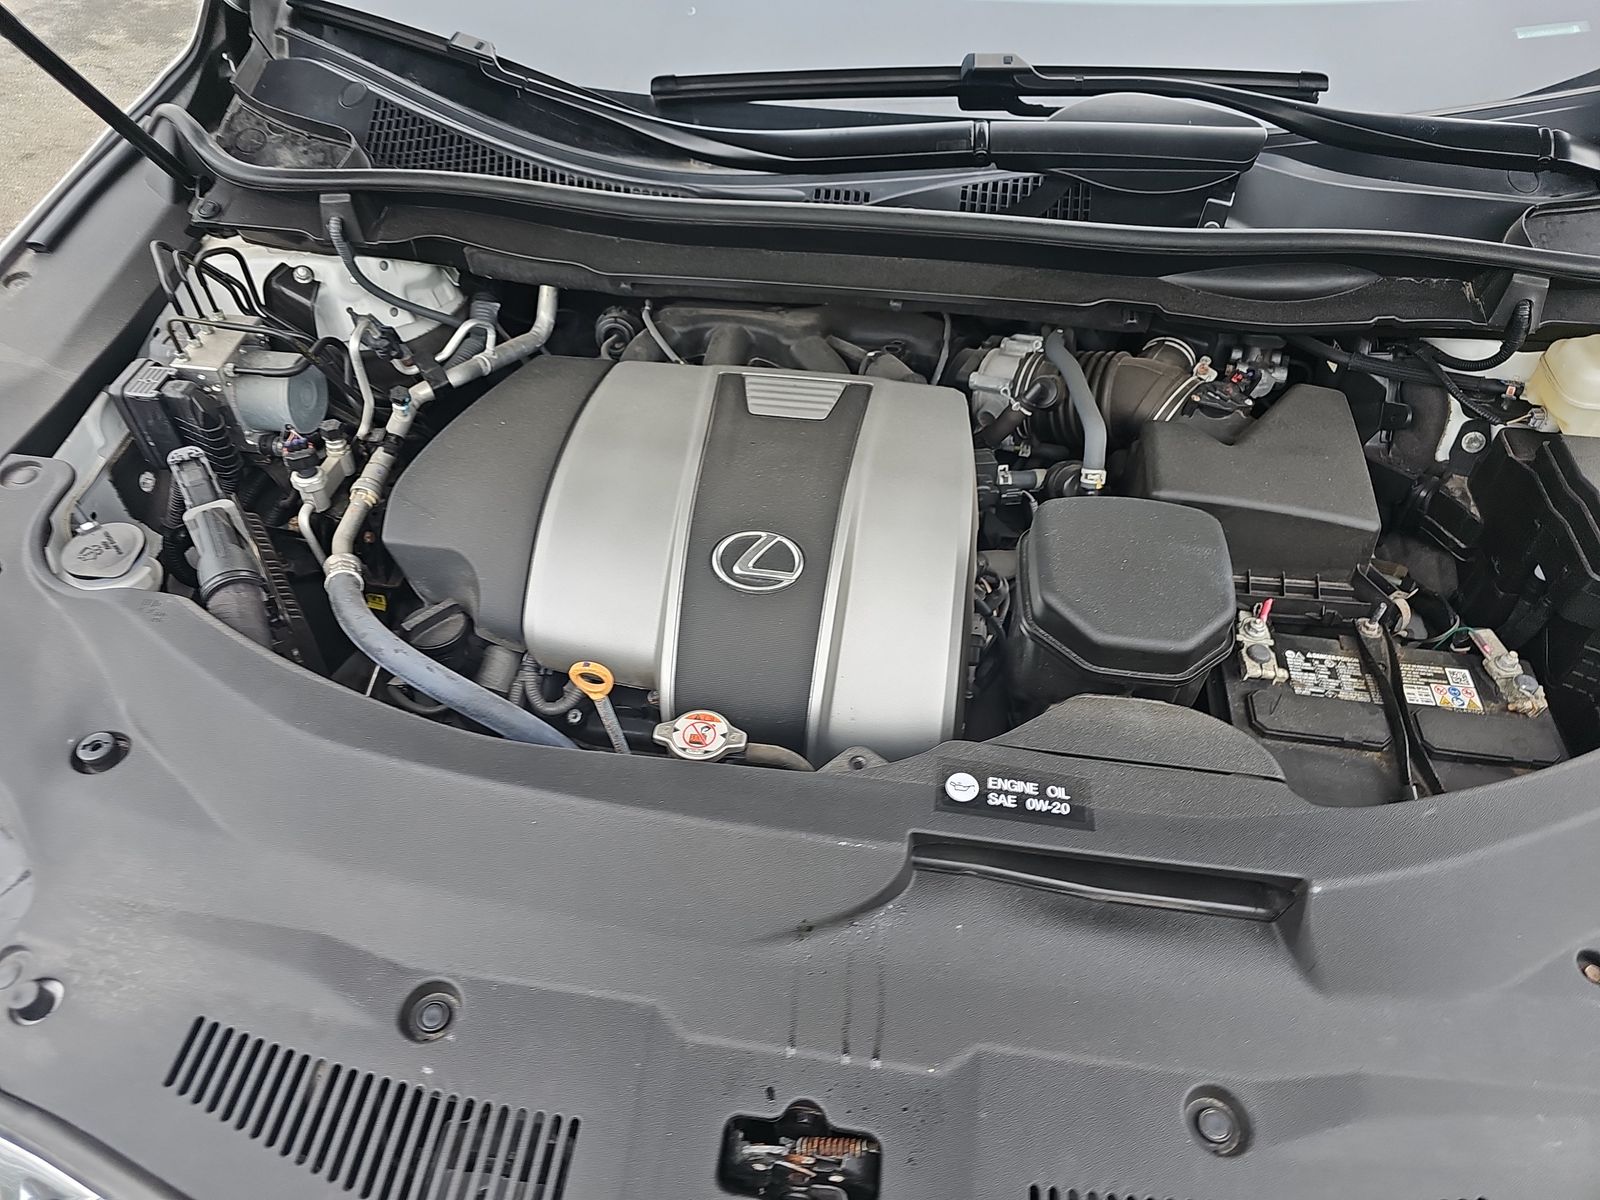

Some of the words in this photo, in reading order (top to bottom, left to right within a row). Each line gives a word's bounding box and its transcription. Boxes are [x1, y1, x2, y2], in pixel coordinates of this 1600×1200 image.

[987, 777, 1039, 795] ENGINE
[1046, 785, 1071, 800] OIL
[987, 793, 1017, 808] SAE
[1025, 798, 1071, 815] 0W-20
